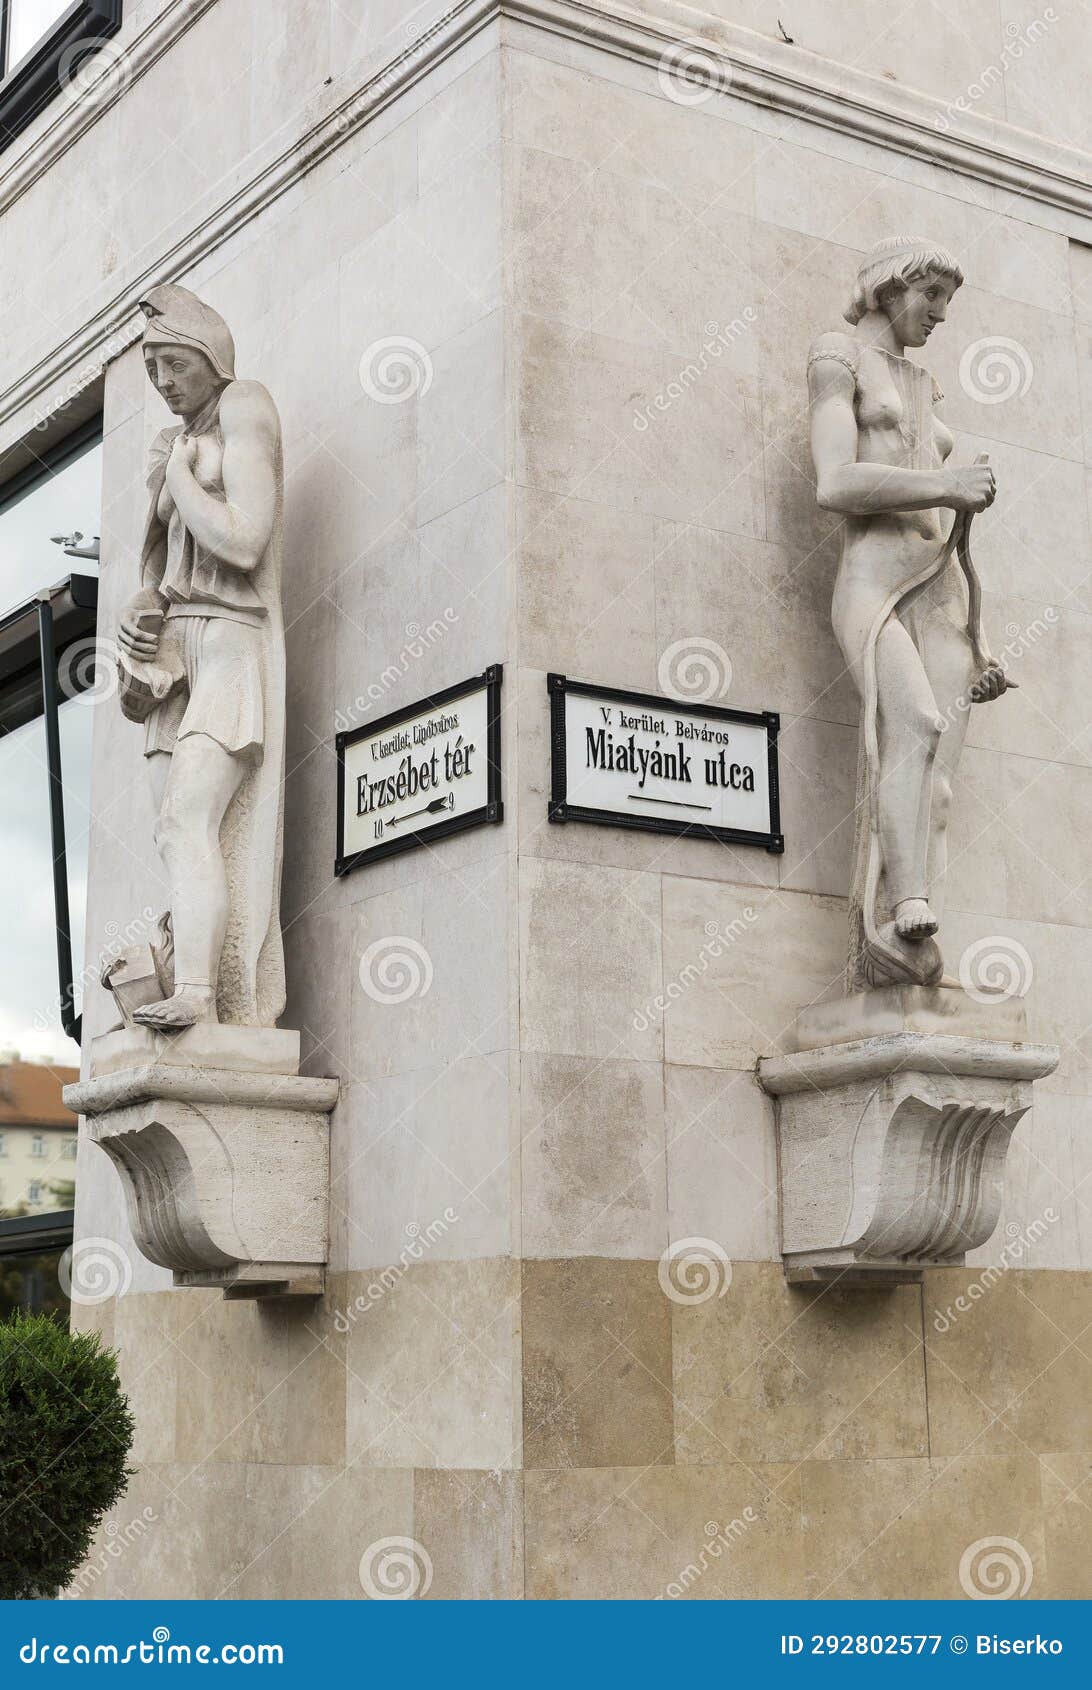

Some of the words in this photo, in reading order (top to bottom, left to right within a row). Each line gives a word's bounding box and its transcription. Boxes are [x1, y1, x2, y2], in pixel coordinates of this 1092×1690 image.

[370, 742, 379, 761] V.
[379, 730, 412, 758] kerület,
[600, 707, 612, 725] V.
[619, 711, 670, 737] kerület,
[675, 720, 729, 746] Belváros
[356, 747, 439, 817] Erzsébet
[444, 735, 475, 782] tér
[585, 726, 692, 788] Miatyánk
[704, 749, 755, 792] utca
[374, 818, 384, 840] 10
[448, 791, 455, 812] 9
